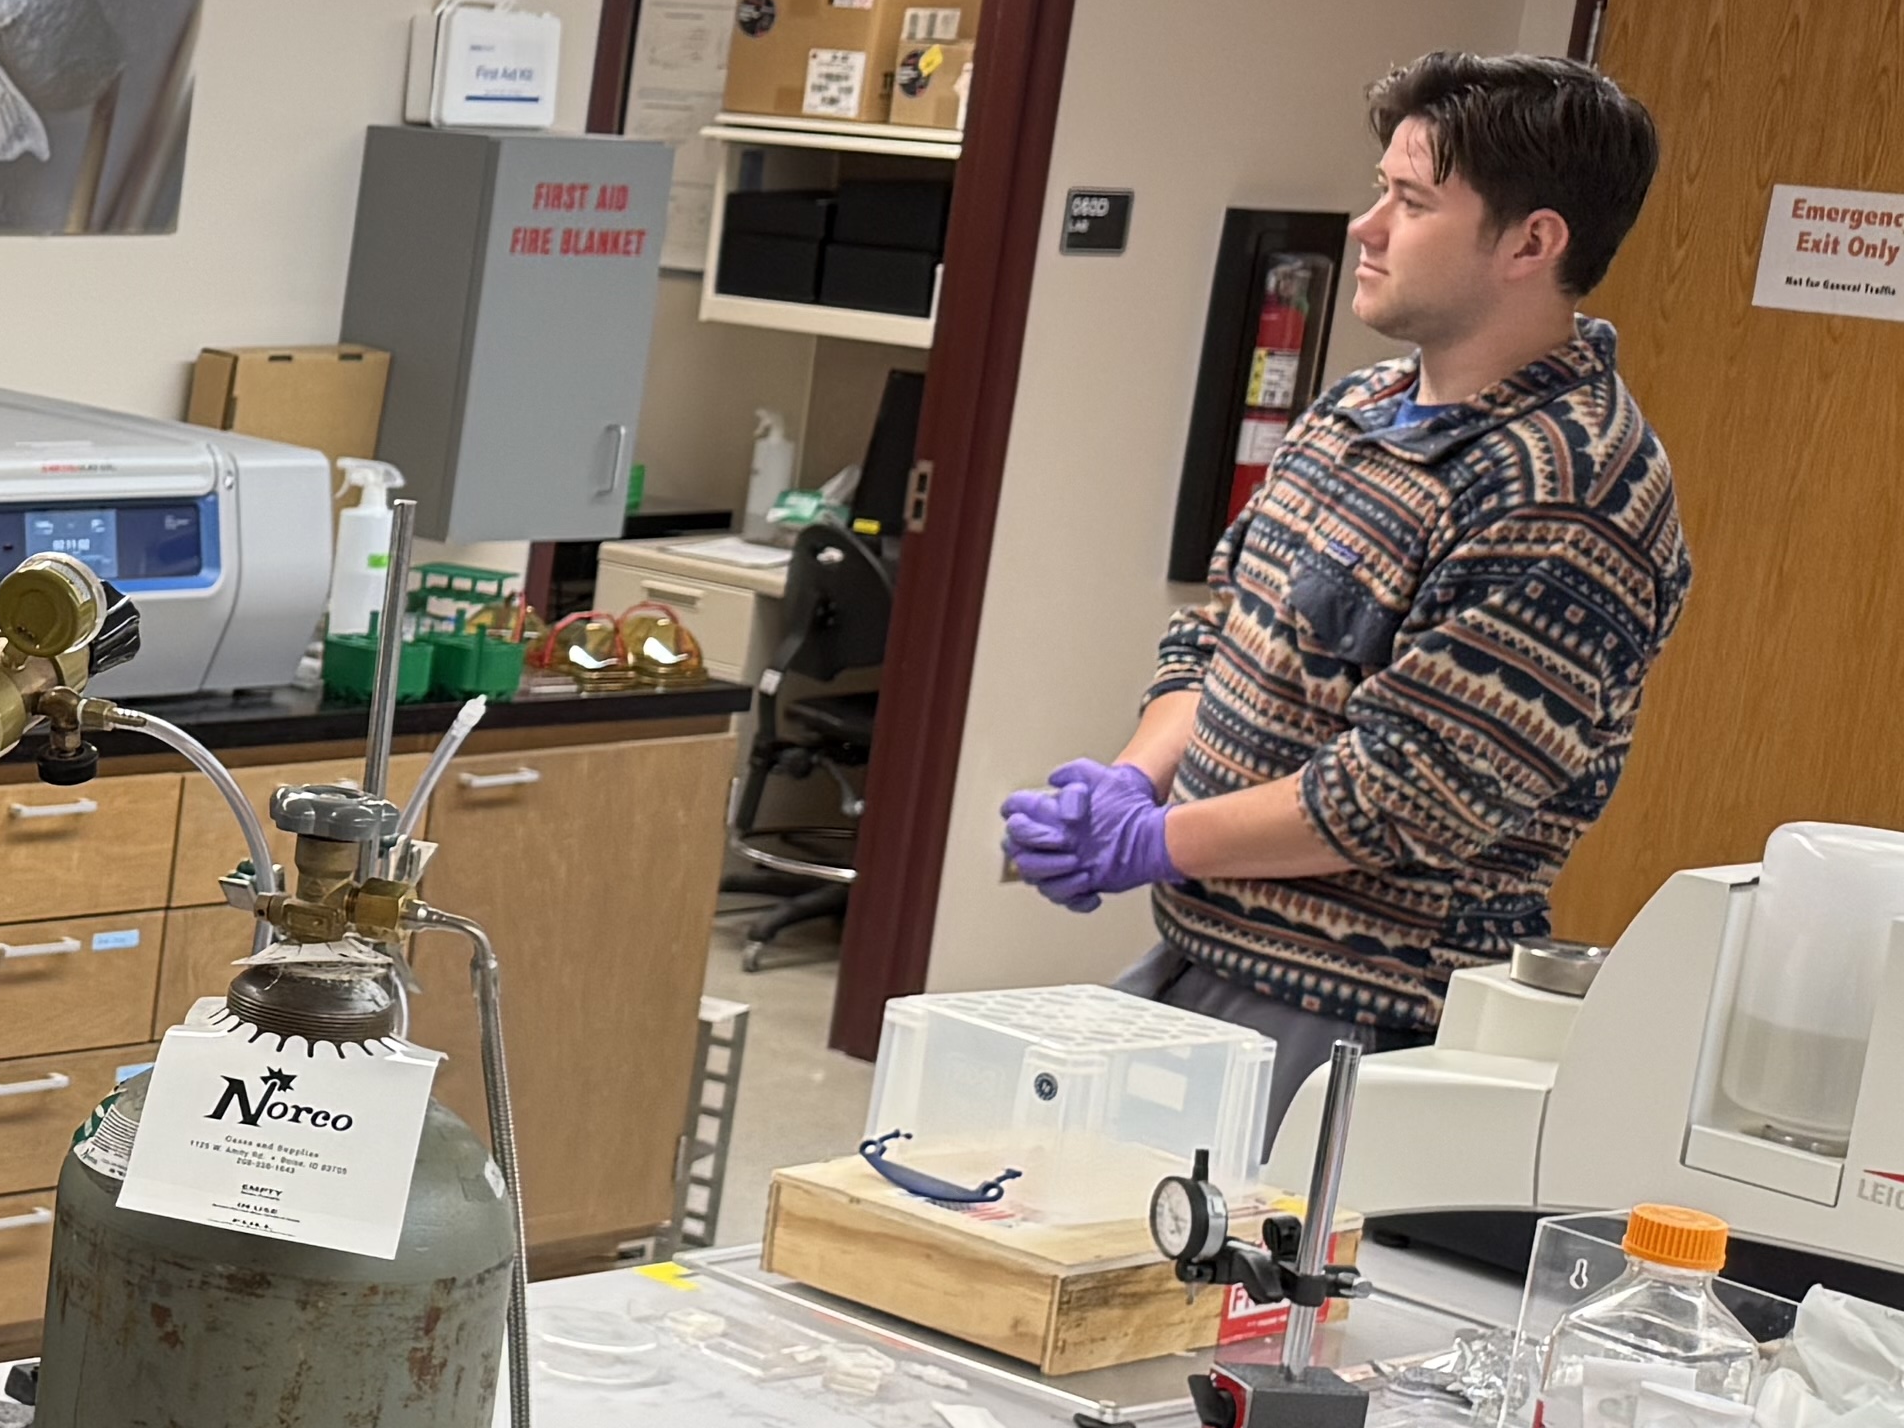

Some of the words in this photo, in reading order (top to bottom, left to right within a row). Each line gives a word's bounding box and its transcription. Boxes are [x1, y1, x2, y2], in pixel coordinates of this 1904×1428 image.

[532, 182, 591, 211] FIRST
[595, 183, 630, 212] AID
[1791, 197, 1904, 232] Emergenc
[510, 227, 554, 255] FIRE
[559, 227, 647, 257] BLANKET
[1795, 231, 1841, 256] Exit
[1847, 235, 1901, 267] Only
[1784, 275, 1803, 287] Not
[1805, 277, 1821, 288] for
[1822, 279, 1862, 293] General
[1864, 283, 1896, 296] Traffic
[204, 1072, 353, 1132] Norco
[256, 1141, 274, 1151] and
[276, 1144, 320, 1159] Supplies
[308, 1161, 319, 1170] ID
[242, 1183, 283, 1197] EMPTY
[1855, 1177, 1904, 1212] LEIC
